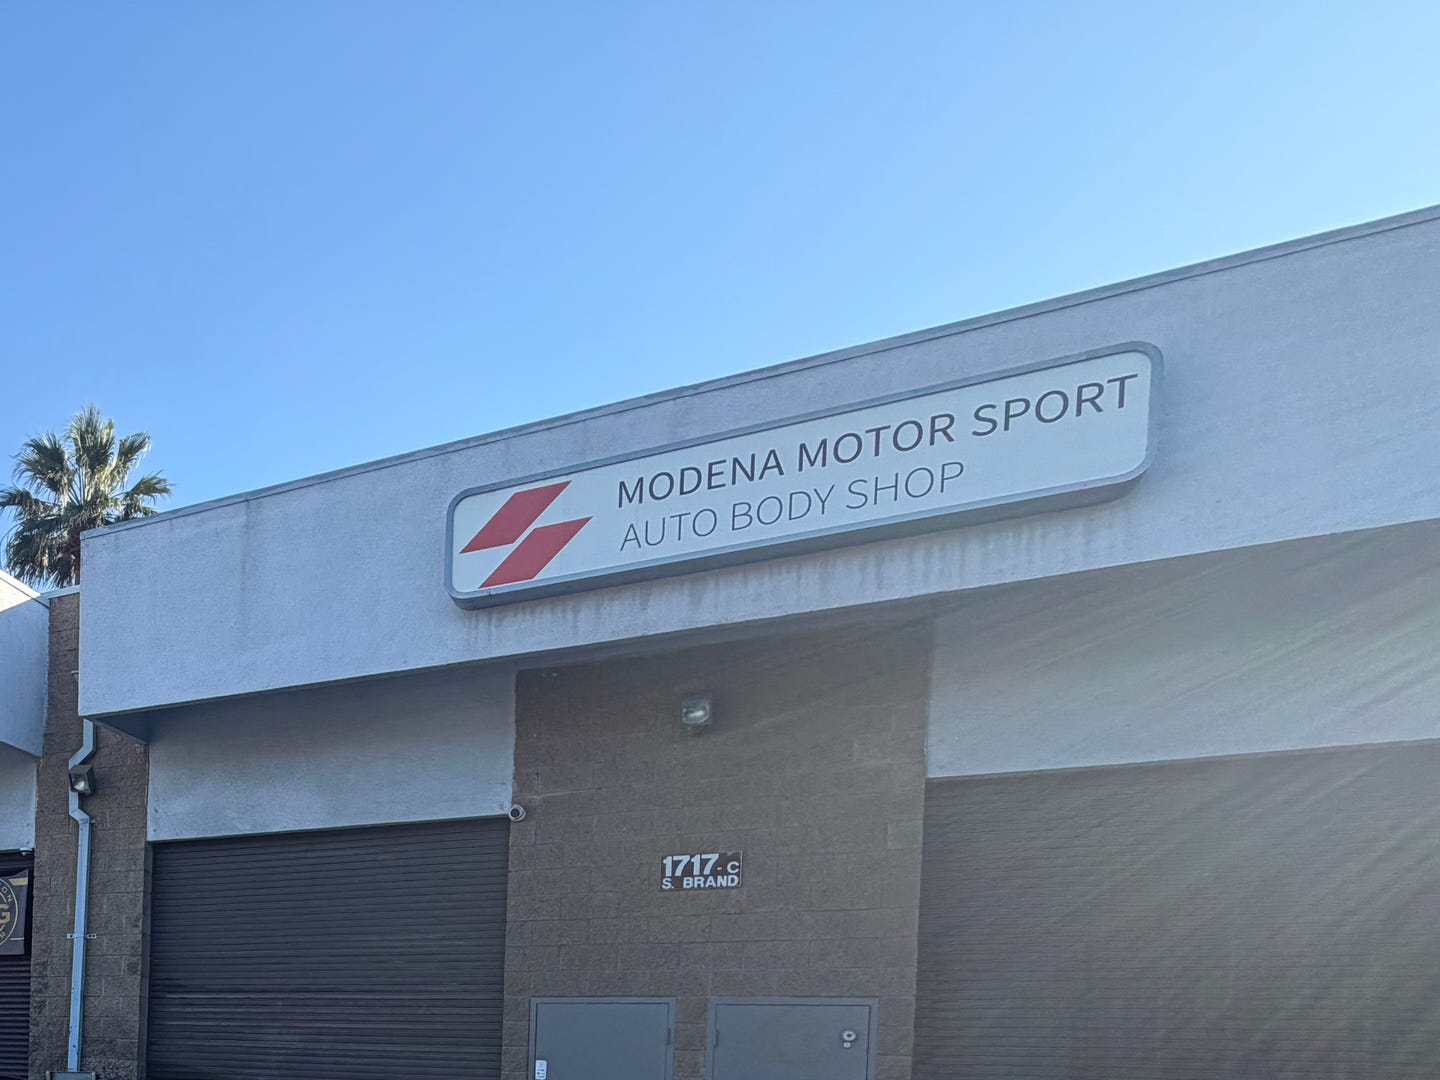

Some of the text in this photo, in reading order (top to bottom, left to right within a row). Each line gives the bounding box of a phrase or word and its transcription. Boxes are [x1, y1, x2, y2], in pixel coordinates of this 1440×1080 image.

[617, 373, 1139, 509] MODENA MOTOR SPORT
[620, 461, 965, 551] AUTO BODY SHOP
[682, 874, 739, 889] BRAND
